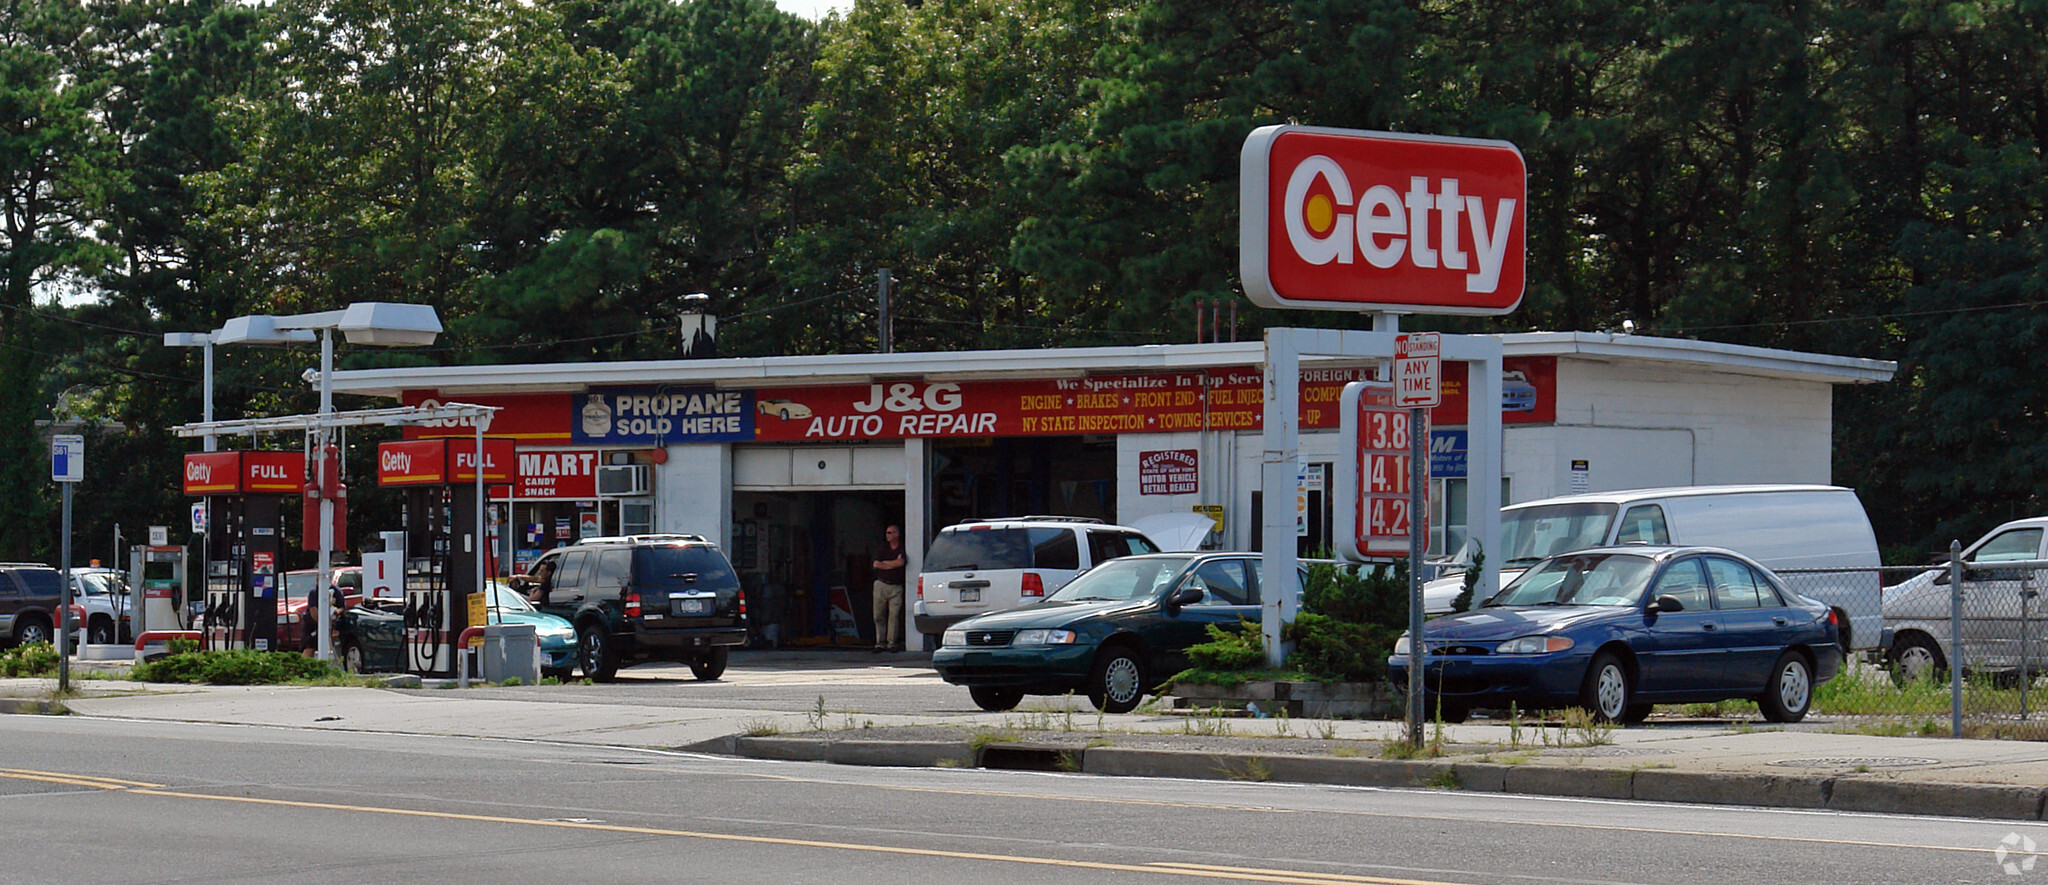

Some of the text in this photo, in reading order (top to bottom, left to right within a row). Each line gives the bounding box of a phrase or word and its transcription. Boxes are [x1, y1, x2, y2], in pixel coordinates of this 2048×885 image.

[1284, 154, 1517, 294] Getty
[1395, 340, 1438, 355] NO STANDING
[1405, 361, 1429, 375] ANY
[1056, 379, 1079, 391] We
[1083, 375, 1168, 392] Specialize
[1175, 375, 1192, 387] In
[1402, 377, 1432, 391] TIME
[616, 393, 742, 416] PROPANE
[853, 382, 962, 413] J&G
[1020, 395, 1062, 410] ENGINE
[1076, 393, 1119, 409] BRAKES
[1134, 392, 1172, 407] FRONT
[1175, 390, 1195, 405] END
[1209, 391, 1234, 405] FUEL
[805, 412, 997, 437] AUTO REPAIR
[1022, 411, 1253, 432] NY STATE INSPECTION TOWING SERVICES
[1307, 409, 1321, 424] UP
[617, 416, 741, 436] SOLD HERE
[1372, 412, 1411, 449] 3.8
[1430, 436, 1457, 453] M
[382, 450, 411, 473] Getty
[457, 453, 495, 468] FUL
[519, 453, 594, 476] MART
[1142, 451, 1195, 468] REGISTERED
[187, 461, 211, 484] Getty
[251, 464, 288, 479] FULL
[1141, 472, 1197, 484] MOTOR VEHICLE
[1372, 454, 1411, 493] 4.1
[525, 477, 556, 486] CANDY
[1143, 482, 1196, 493] RETAIL DEALER
[525, 487, 556, 496] SNACK
[1371, 499, 1411, 535] 4.2
